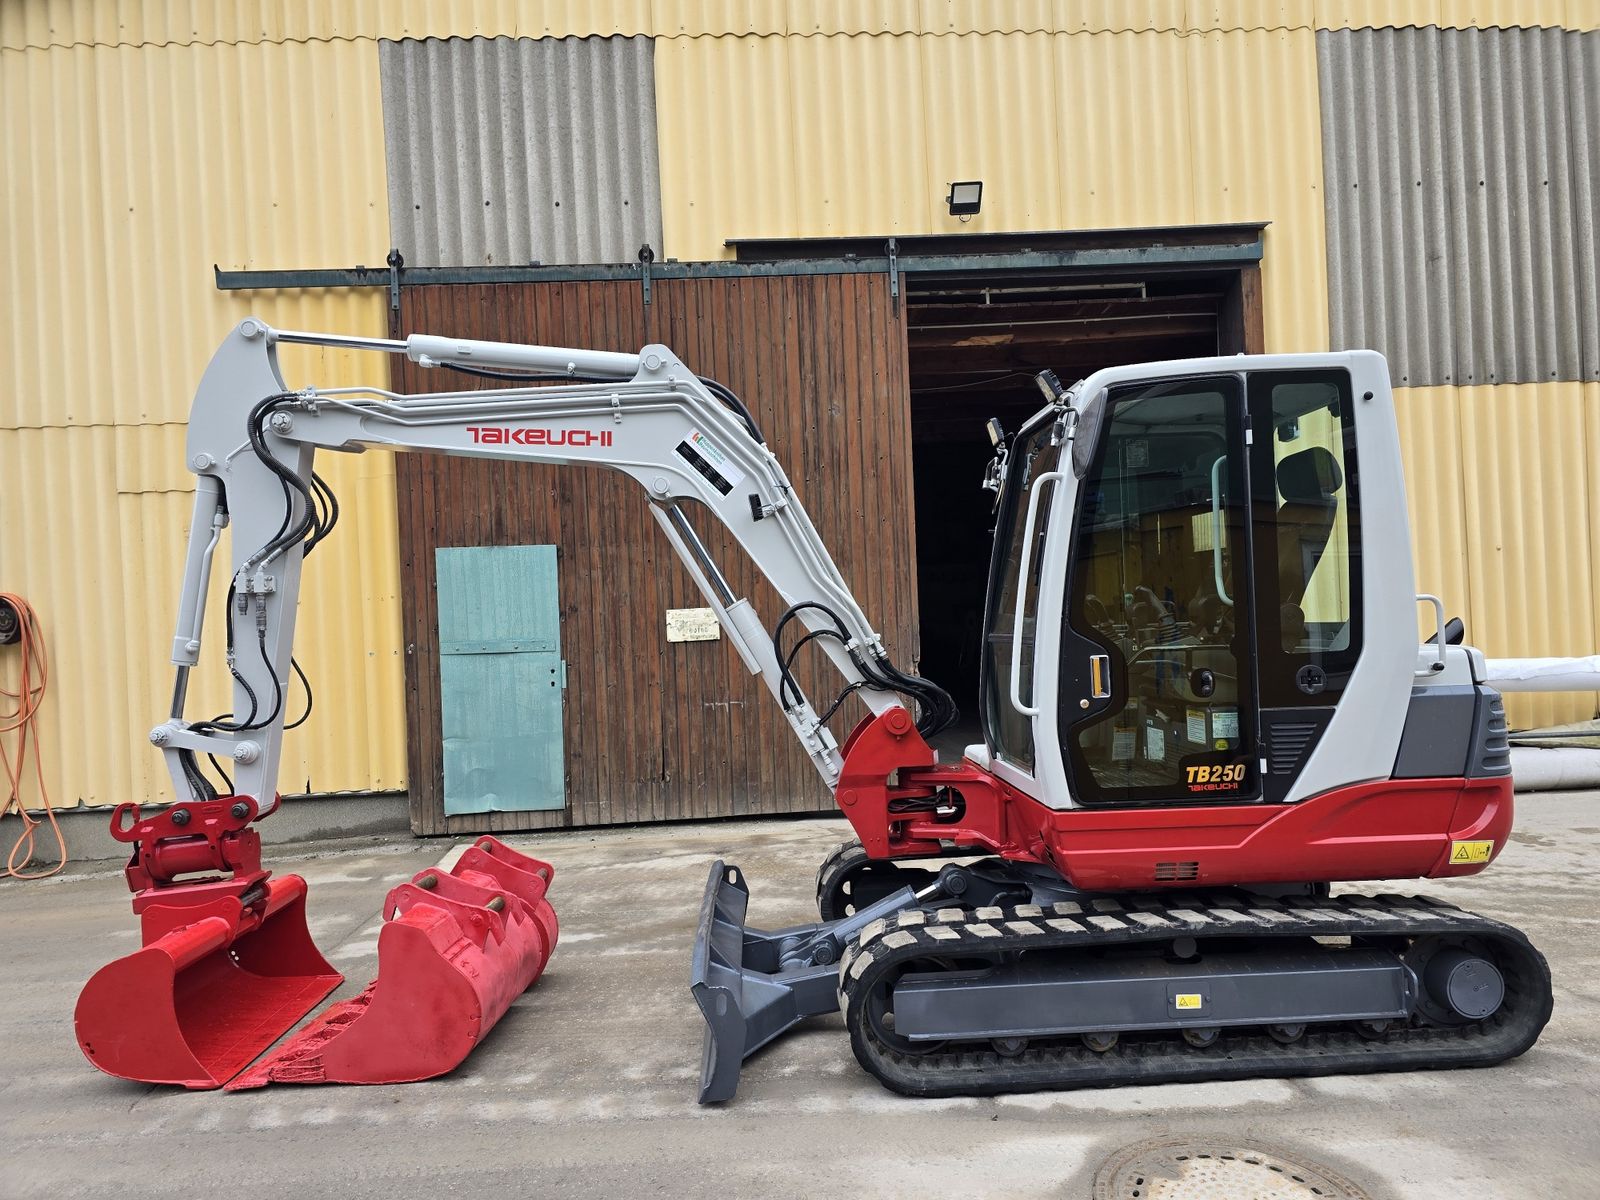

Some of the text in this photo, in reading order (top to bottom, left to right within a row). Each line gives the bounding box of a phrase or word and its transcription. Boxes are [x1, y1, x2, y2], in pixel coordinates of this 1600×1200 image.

[466, 427, 613, 447] TAKEUCHI
[1186, 764, 1246, 783] TB250
[1188, 782, 1239, 792] TAKEUCHI
